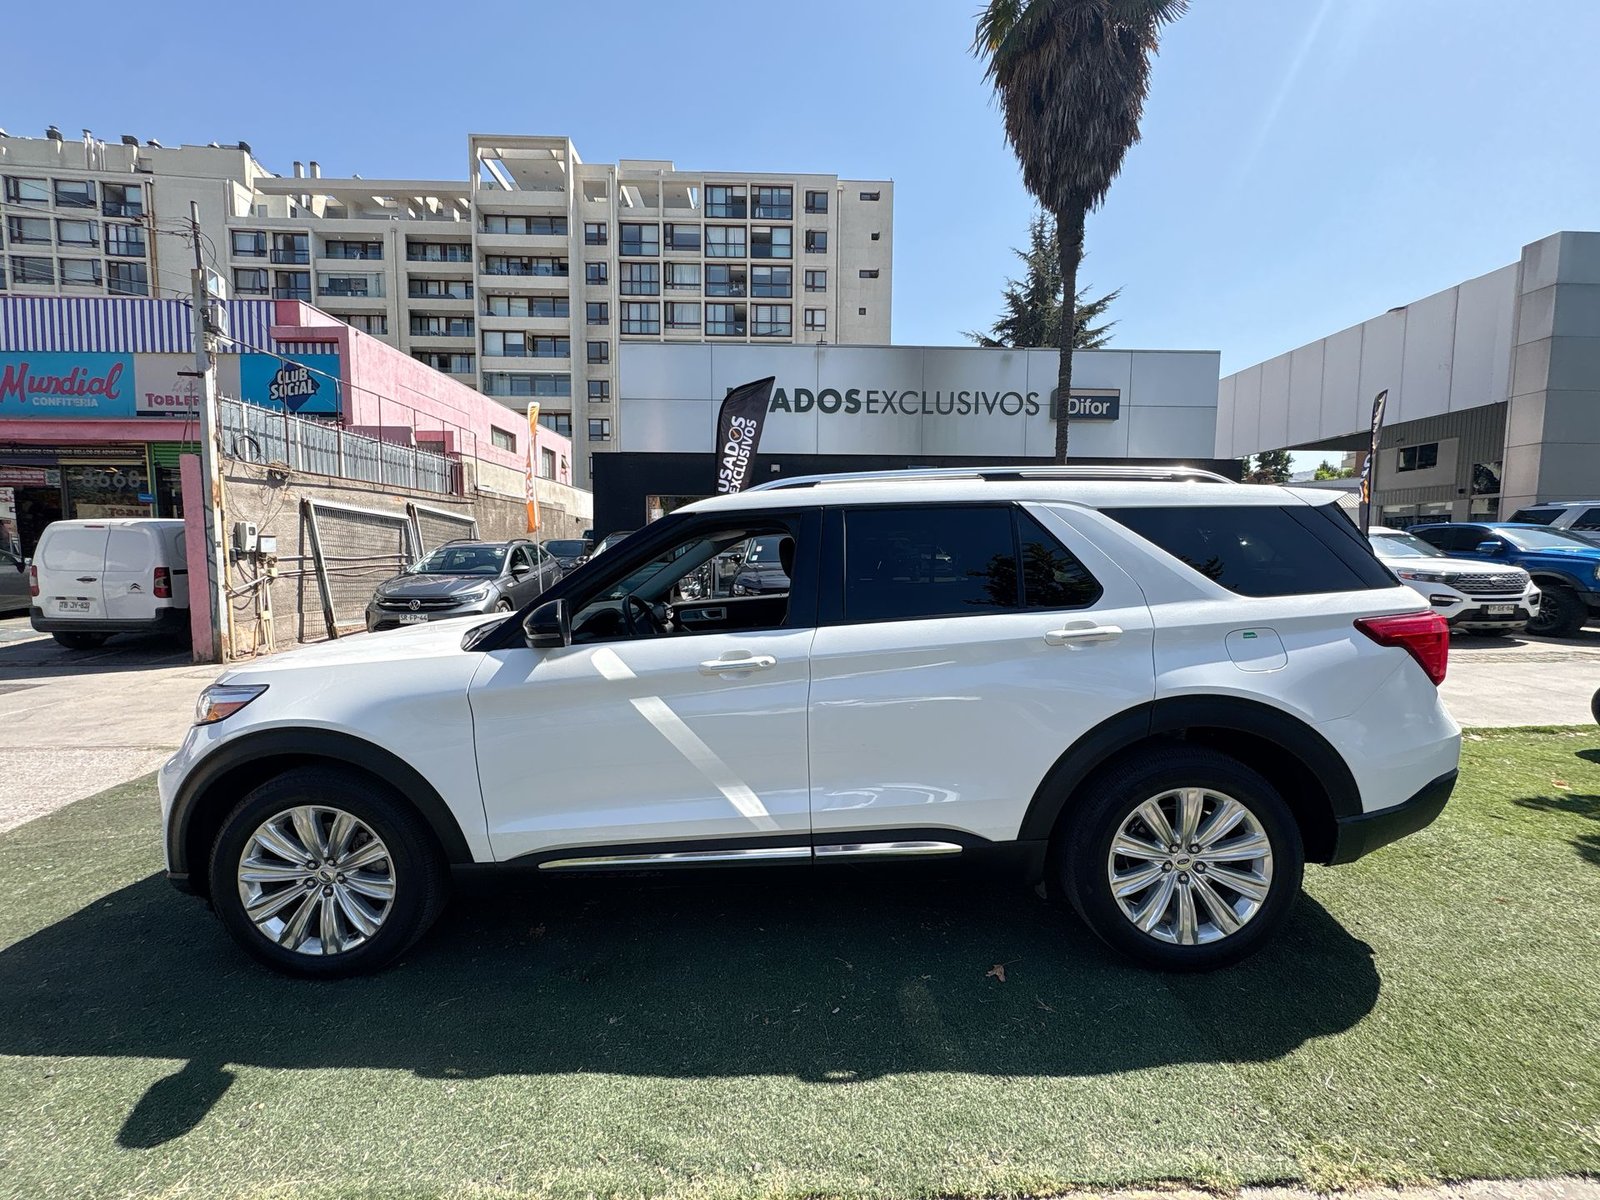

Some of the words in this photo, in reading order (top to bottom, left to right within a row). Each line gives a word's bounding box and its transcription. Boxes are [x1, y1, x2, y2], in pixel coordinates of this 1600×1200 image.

[0, 362, 124, 404] Mundial
[277, 368, 308, 384] CLUB
[727, 388, 861, 414] ADOS
[866, 390, 1040, 416] EXCLUSIVOS
[1068, 398, 1110, 415] Difor
[718, 416, 746, 493] USADOS
[729, 419, 757, 494] EXCLUSIVOS
